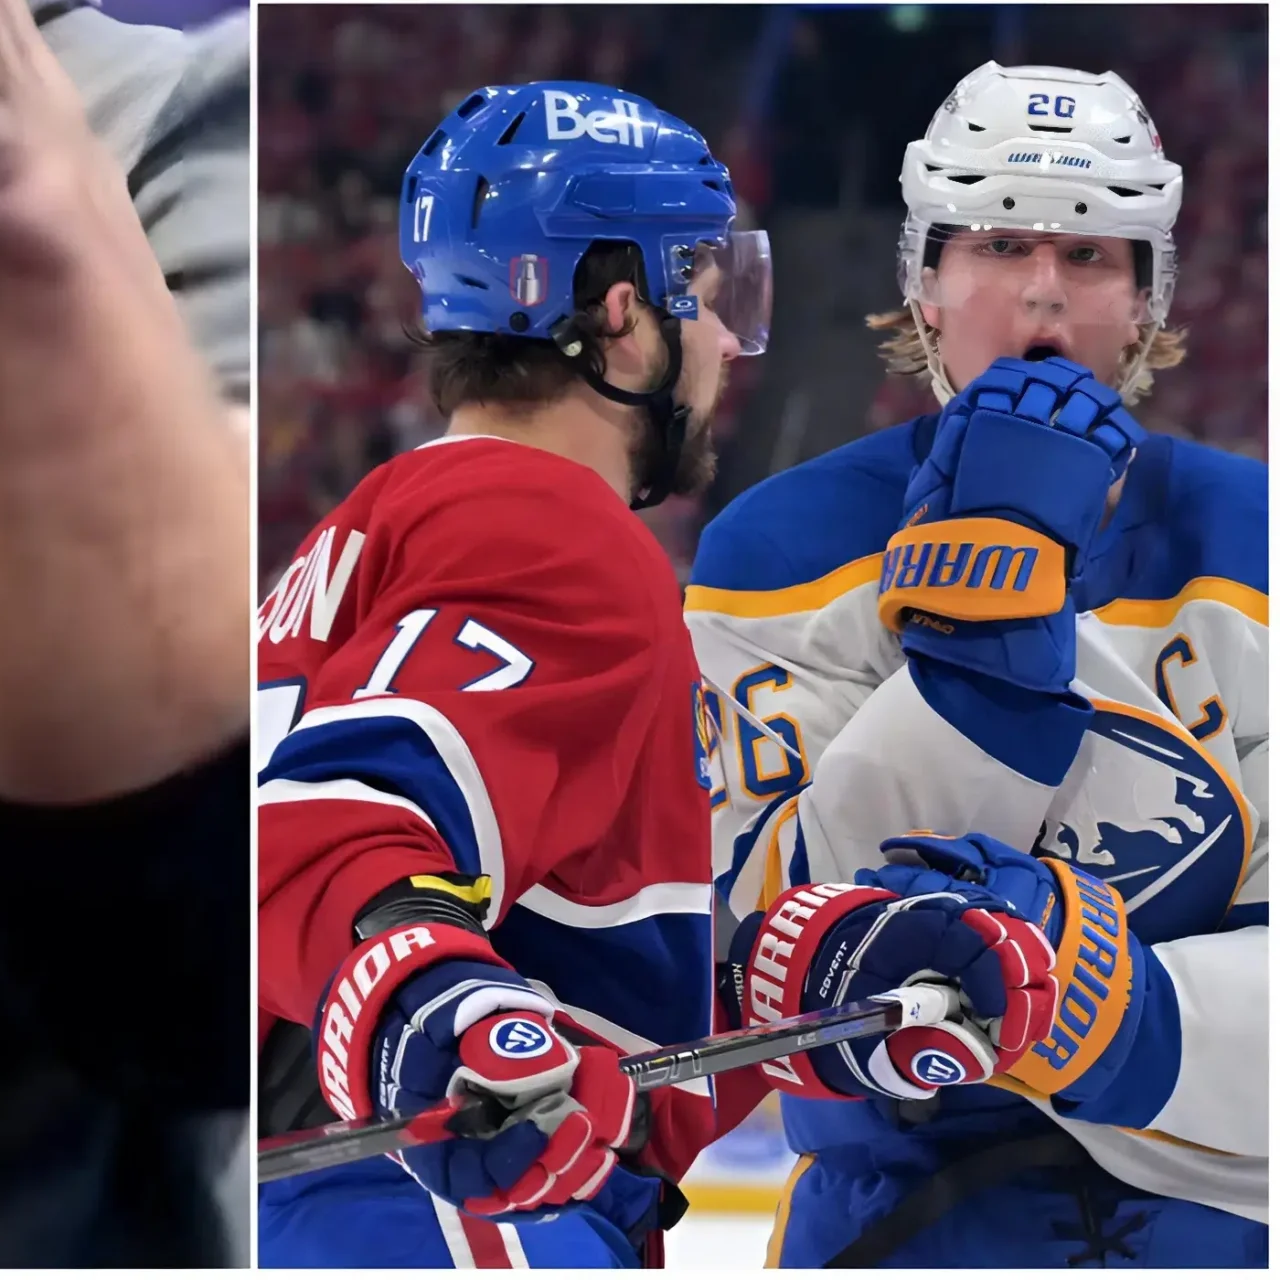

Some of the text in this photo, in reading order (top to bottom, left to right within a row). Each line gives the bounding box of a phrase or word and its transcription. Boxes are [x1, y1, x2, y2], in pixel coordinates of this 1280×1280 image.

[543, 89, 645, 149] Bell
[413, 195, 435, 243] 17
[351, 607, 537, 700] 17
